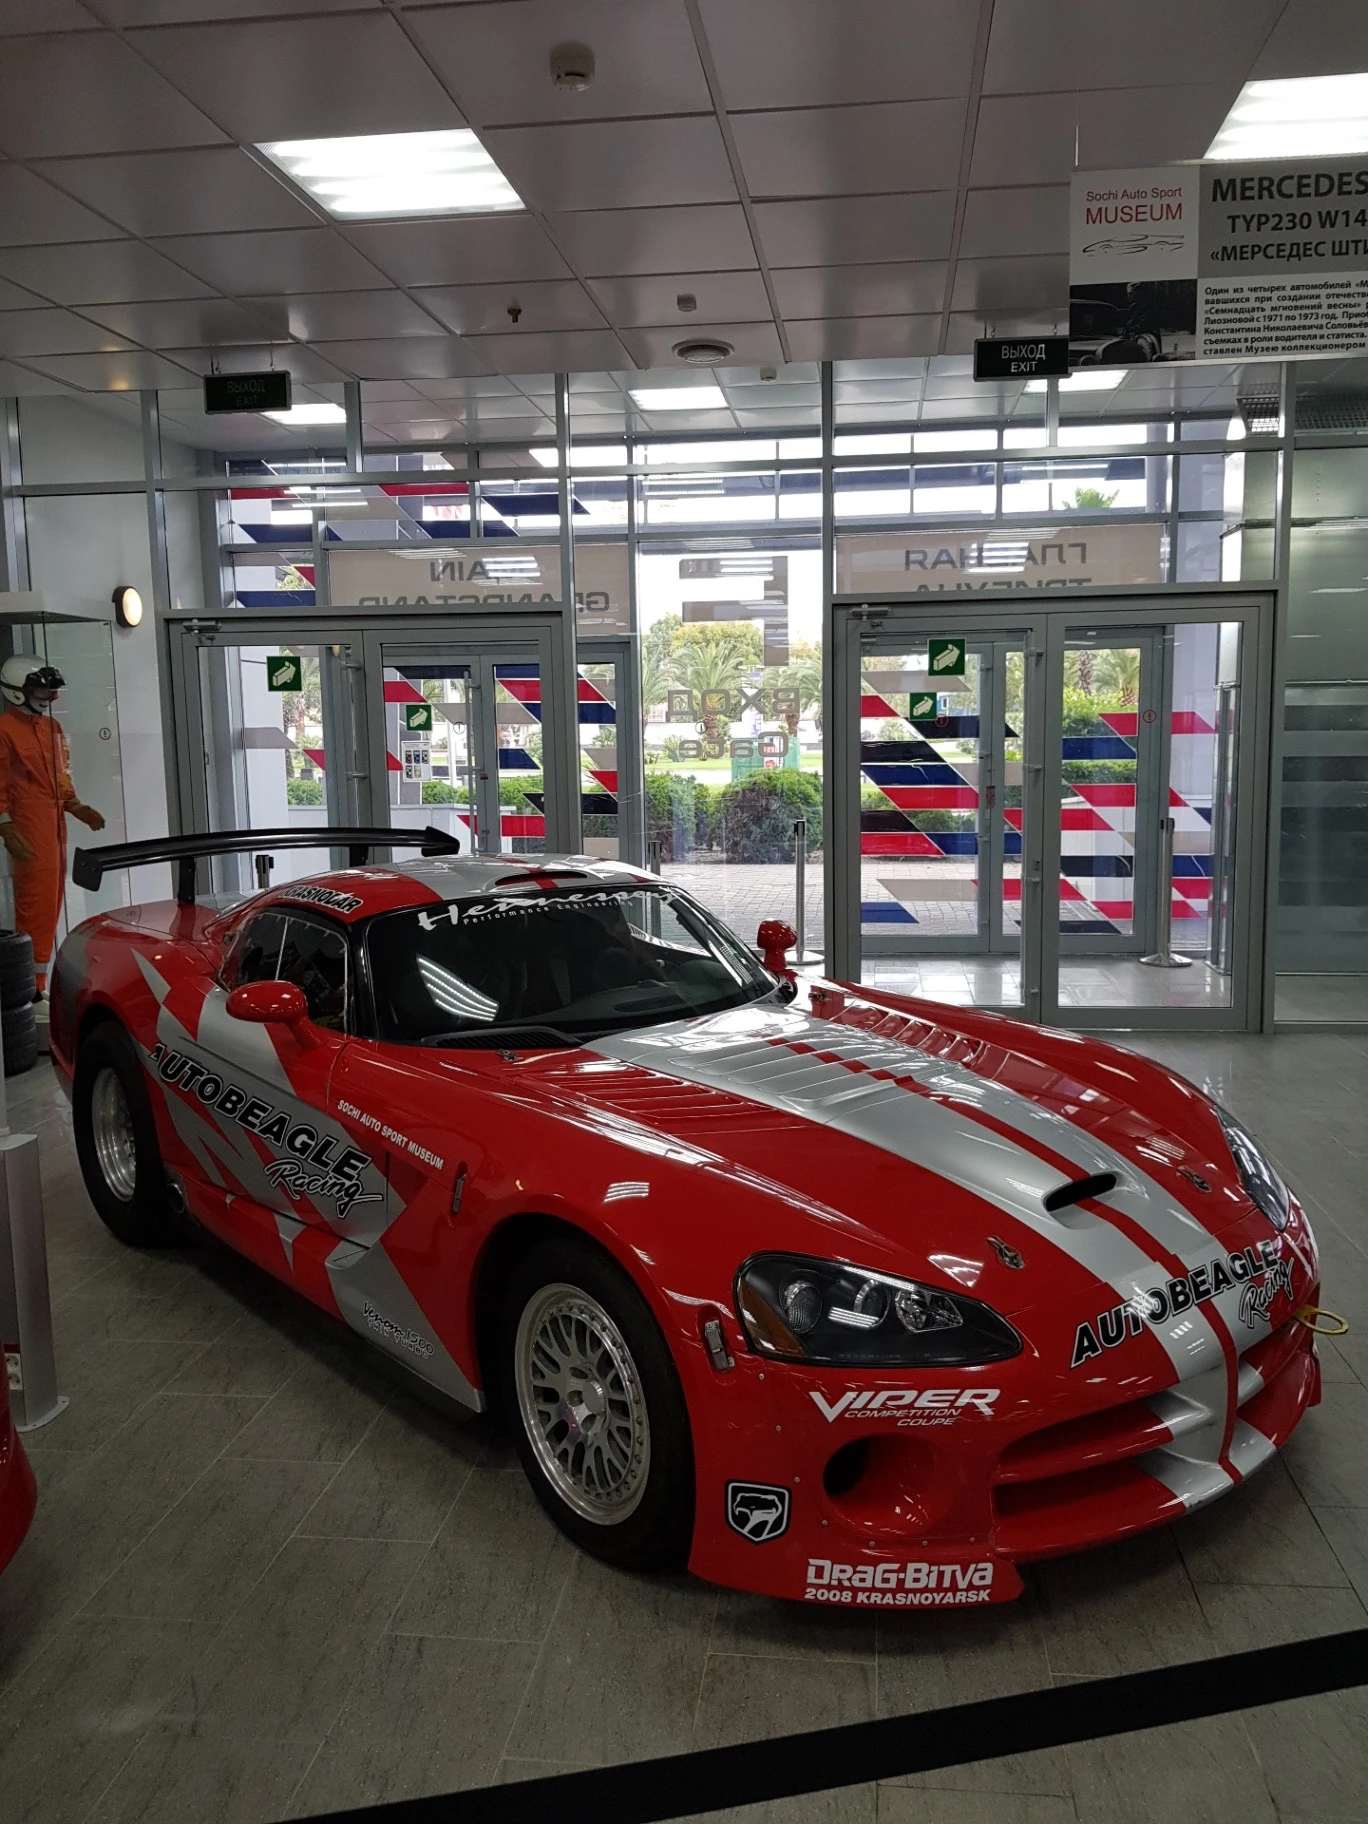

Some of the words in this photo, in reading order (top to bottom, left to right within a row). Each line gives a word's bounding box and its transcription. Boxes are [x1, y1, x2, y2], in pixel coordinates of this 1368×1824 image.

[1086, 189, 1118, 202] Sochi
[1121, 188, 1148, 200] Auto
[1151, 186, 1182, 200] Sport
[1211, 170, 1368, 202] MERCEDES
[1086, 202, 1182, 224] MUSEUM
[1227, 211, 1313, 234] TYP230
[1210, 240, 1326, 262] «МЕРСЕДЕС
[1204, 286, 1229, 296] Один
[1248, 284, 1287, 295] четырех
[1290, 279, 1351, 292] автомобилей
[1204, 296, 1250, 305] вавшихся
[1254, 295, 1272, 304] при
[1276, 293, 1321, 303] создании
[1204, 305, 1266, 316] «Семнадцать
[1270, 302, 1323, 312] мгновений
[1327, 301, 1361, 310] весны»
[1204, 314, 1255, 325] Лиозновой
[1263, 314, 1283, 323] 1971
[1299, 312, 1319, 321] 1973
[1320, 312, 1339, 321] год.
[1204, 325, 1261, 335] Константина
[1263, 323, 1324, 333] Николаевича
[1203, 336, 1242, 345] съемках
[1250, 335, 1273, 345] роли
[1274, 333, 1318, 343] водителя
[1326, 331, 1367, 340] статиста.
[1001, 343, 1046, 360] ВЫХОД
[1203, 346, 1243, 355] ставлен
[1245, 344, 1279, 355] Музею
[1281, 341, 1366, 352] коллекционером
[1010, 361, 1037, 373] EXIT
[226, 379, 265, 393] ВЫХОД
[463, 906, 549, 925] Performance
[557, 901, 634, 910] Engineering
[150, 1042, 373, 1183] AUTOBEAGLE
[337, 1099, 361, 1120] SOCHI
[360, 1112, 382, 1132] AUTO
[381, 1125, 408, 1148] SPORT
[407, 1140, 444, 1171] MUSEUM
[264, 1157, 383, 1219] Racing
[1239, 1256, 1296, 1329] Racing
[1070, 1239, 1279, 1370] AUTOBEAGLE
[362, 1300, 405, 1337] Venom
[808, 1388, 1001, 1423] VIPER
[844, 1408, 962, 1419] COMPETITION
[896, 1417, 957, 1427] COUPE
[804, 1587, 853, 1603] 2008
[856, 1588, 992, 1605] KRASNOYARSK
